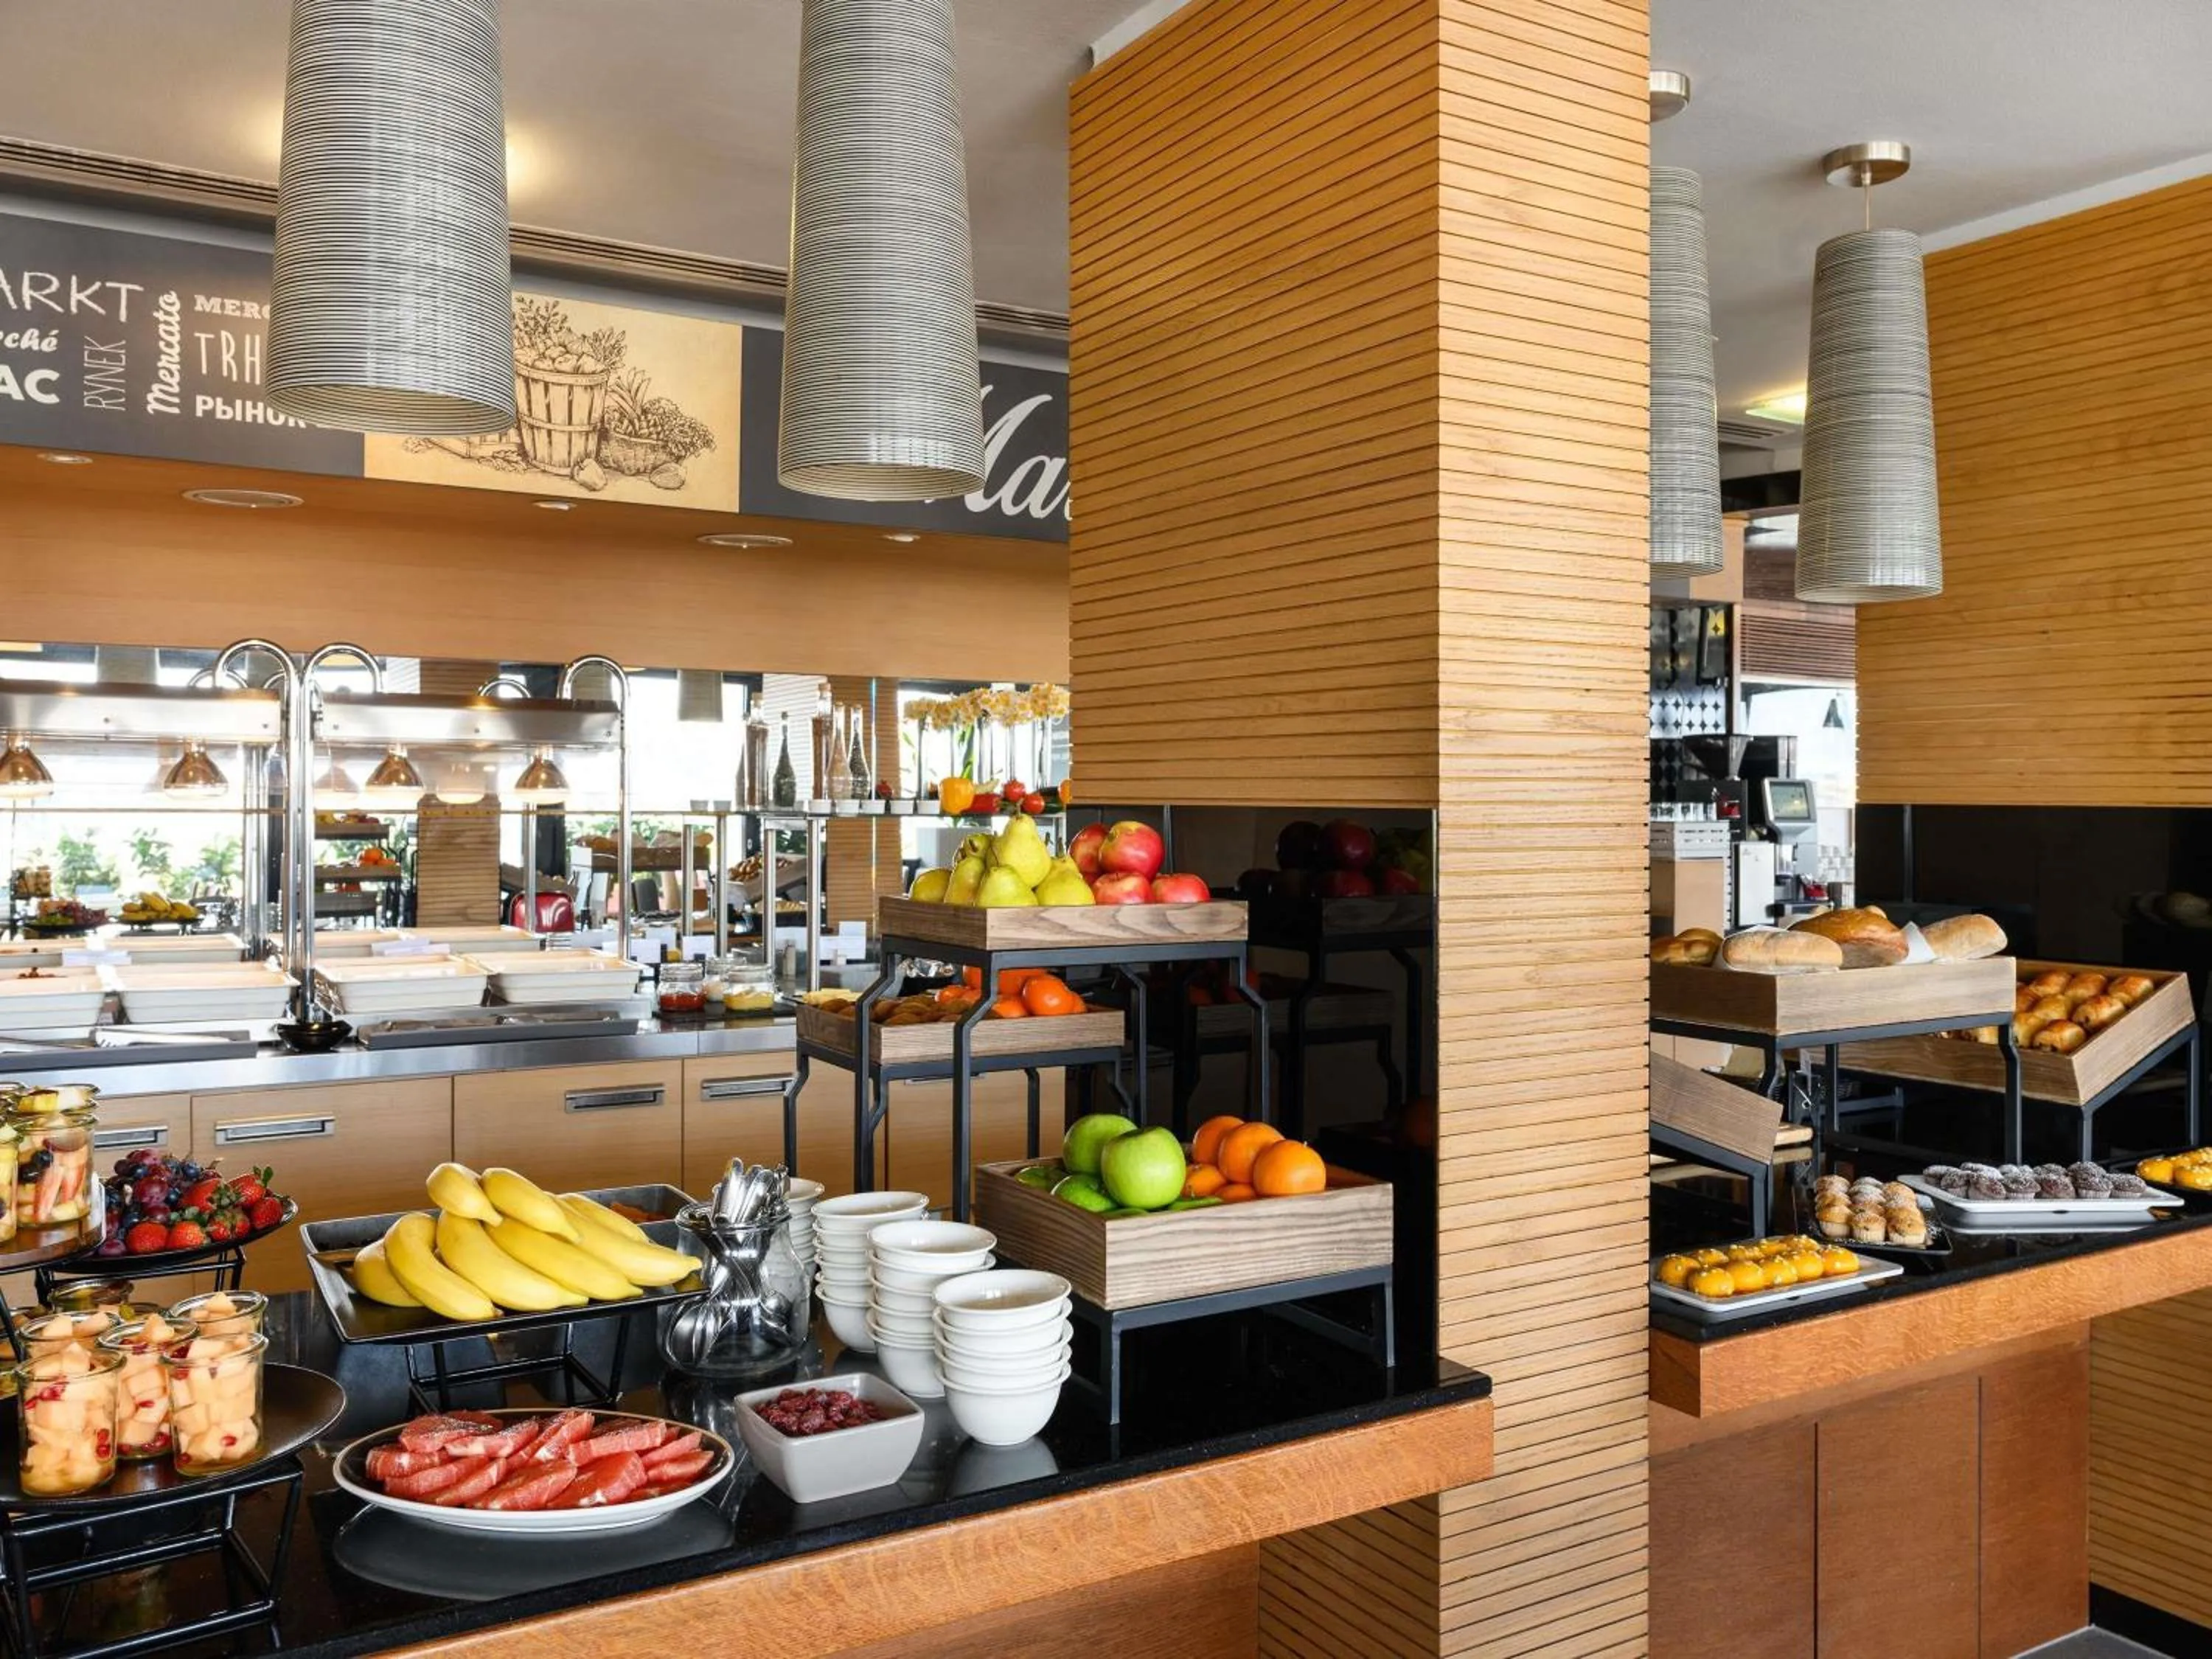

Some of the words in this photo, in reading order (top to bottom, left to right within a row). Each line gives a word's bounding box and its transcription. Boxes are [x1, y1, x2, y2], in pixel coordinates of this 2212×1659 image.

[0, 328, 60, 352] ché
[147, 291, 181, 414] Mercato
[194, 330, 260, 385] TRH
[83, 335, 126, 411] RYNEK
